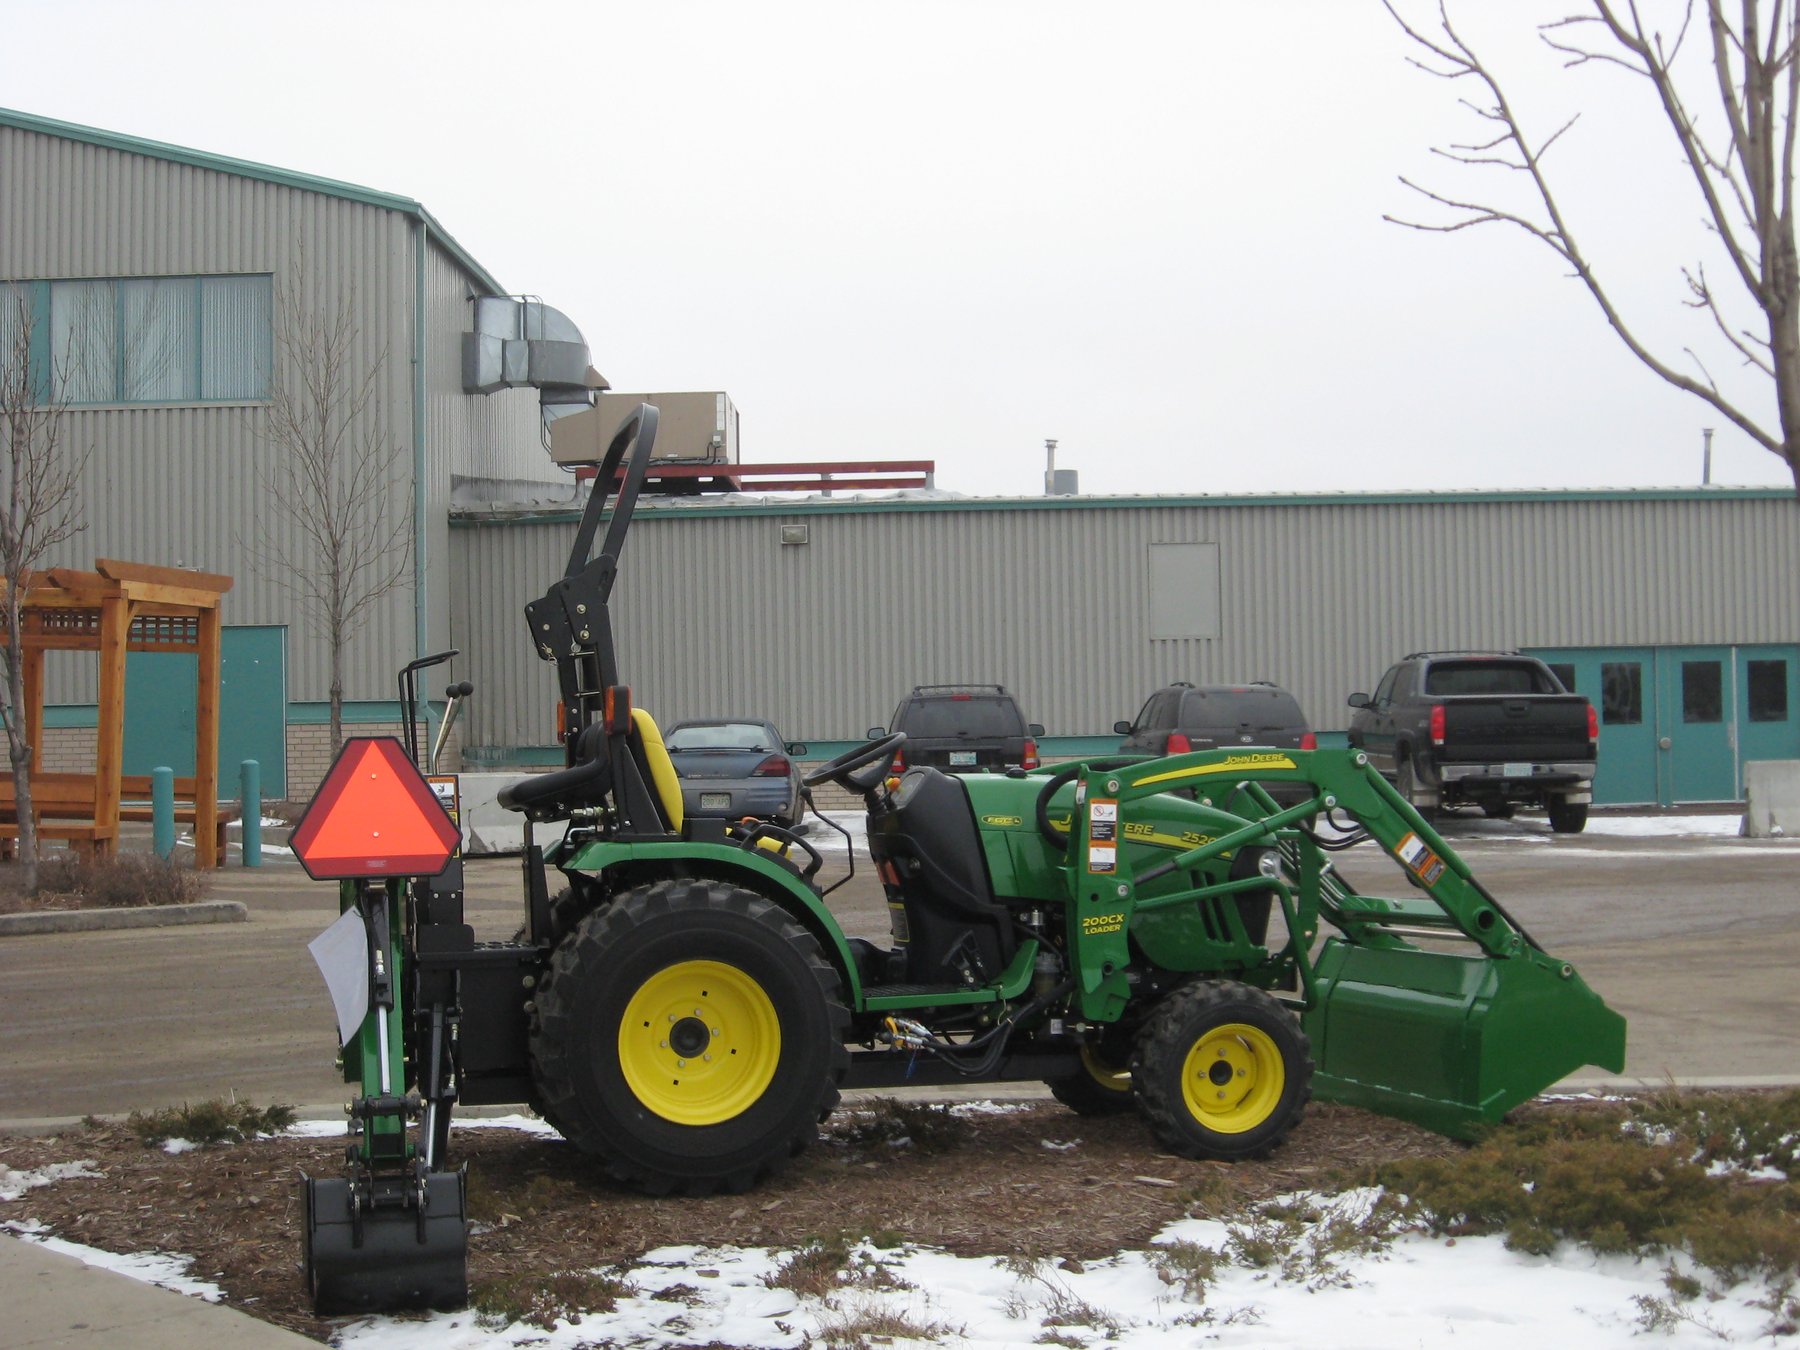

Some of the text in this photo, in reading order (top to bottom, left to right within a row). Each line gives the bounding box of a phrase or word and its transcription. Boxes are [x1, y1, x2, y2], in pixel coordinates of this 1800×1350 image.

[1224, 753, 1285, 765] JOHN DEERE
[1122, 822, 1154, 835] ERE
[1082, 913, 1125, 927] 200CX
[1085, 924, 1121, 935] LOADER
